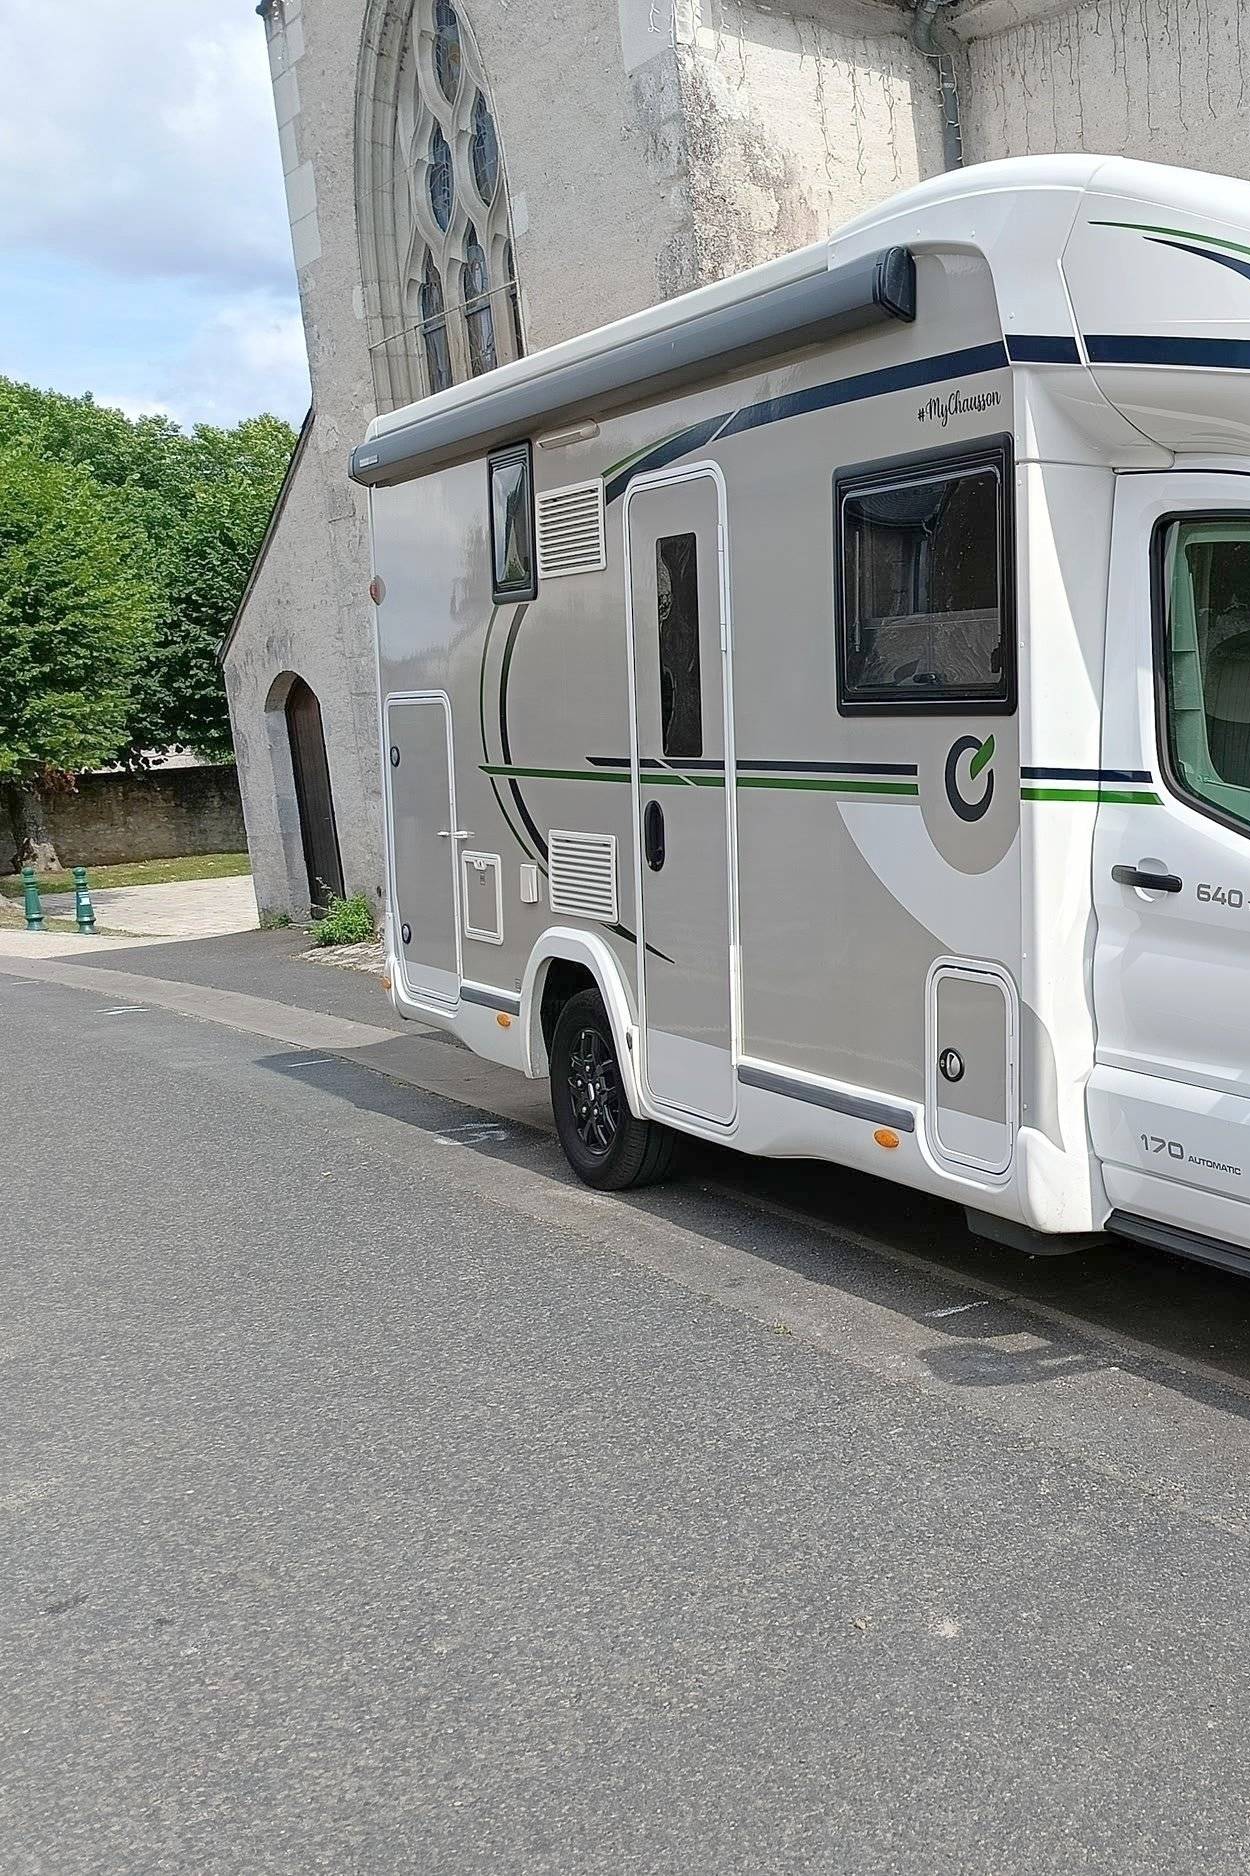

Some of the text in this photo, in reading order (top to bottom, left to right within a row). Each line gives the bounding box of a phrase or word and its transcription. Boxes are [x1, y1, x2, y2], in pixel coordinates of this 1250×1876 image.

[917, 389, 1001, 428] #MyChausson
[1196, 883, 1243, 908] 640
[1140, 1133, 1241, 1175] 170 AUTOMATIC
